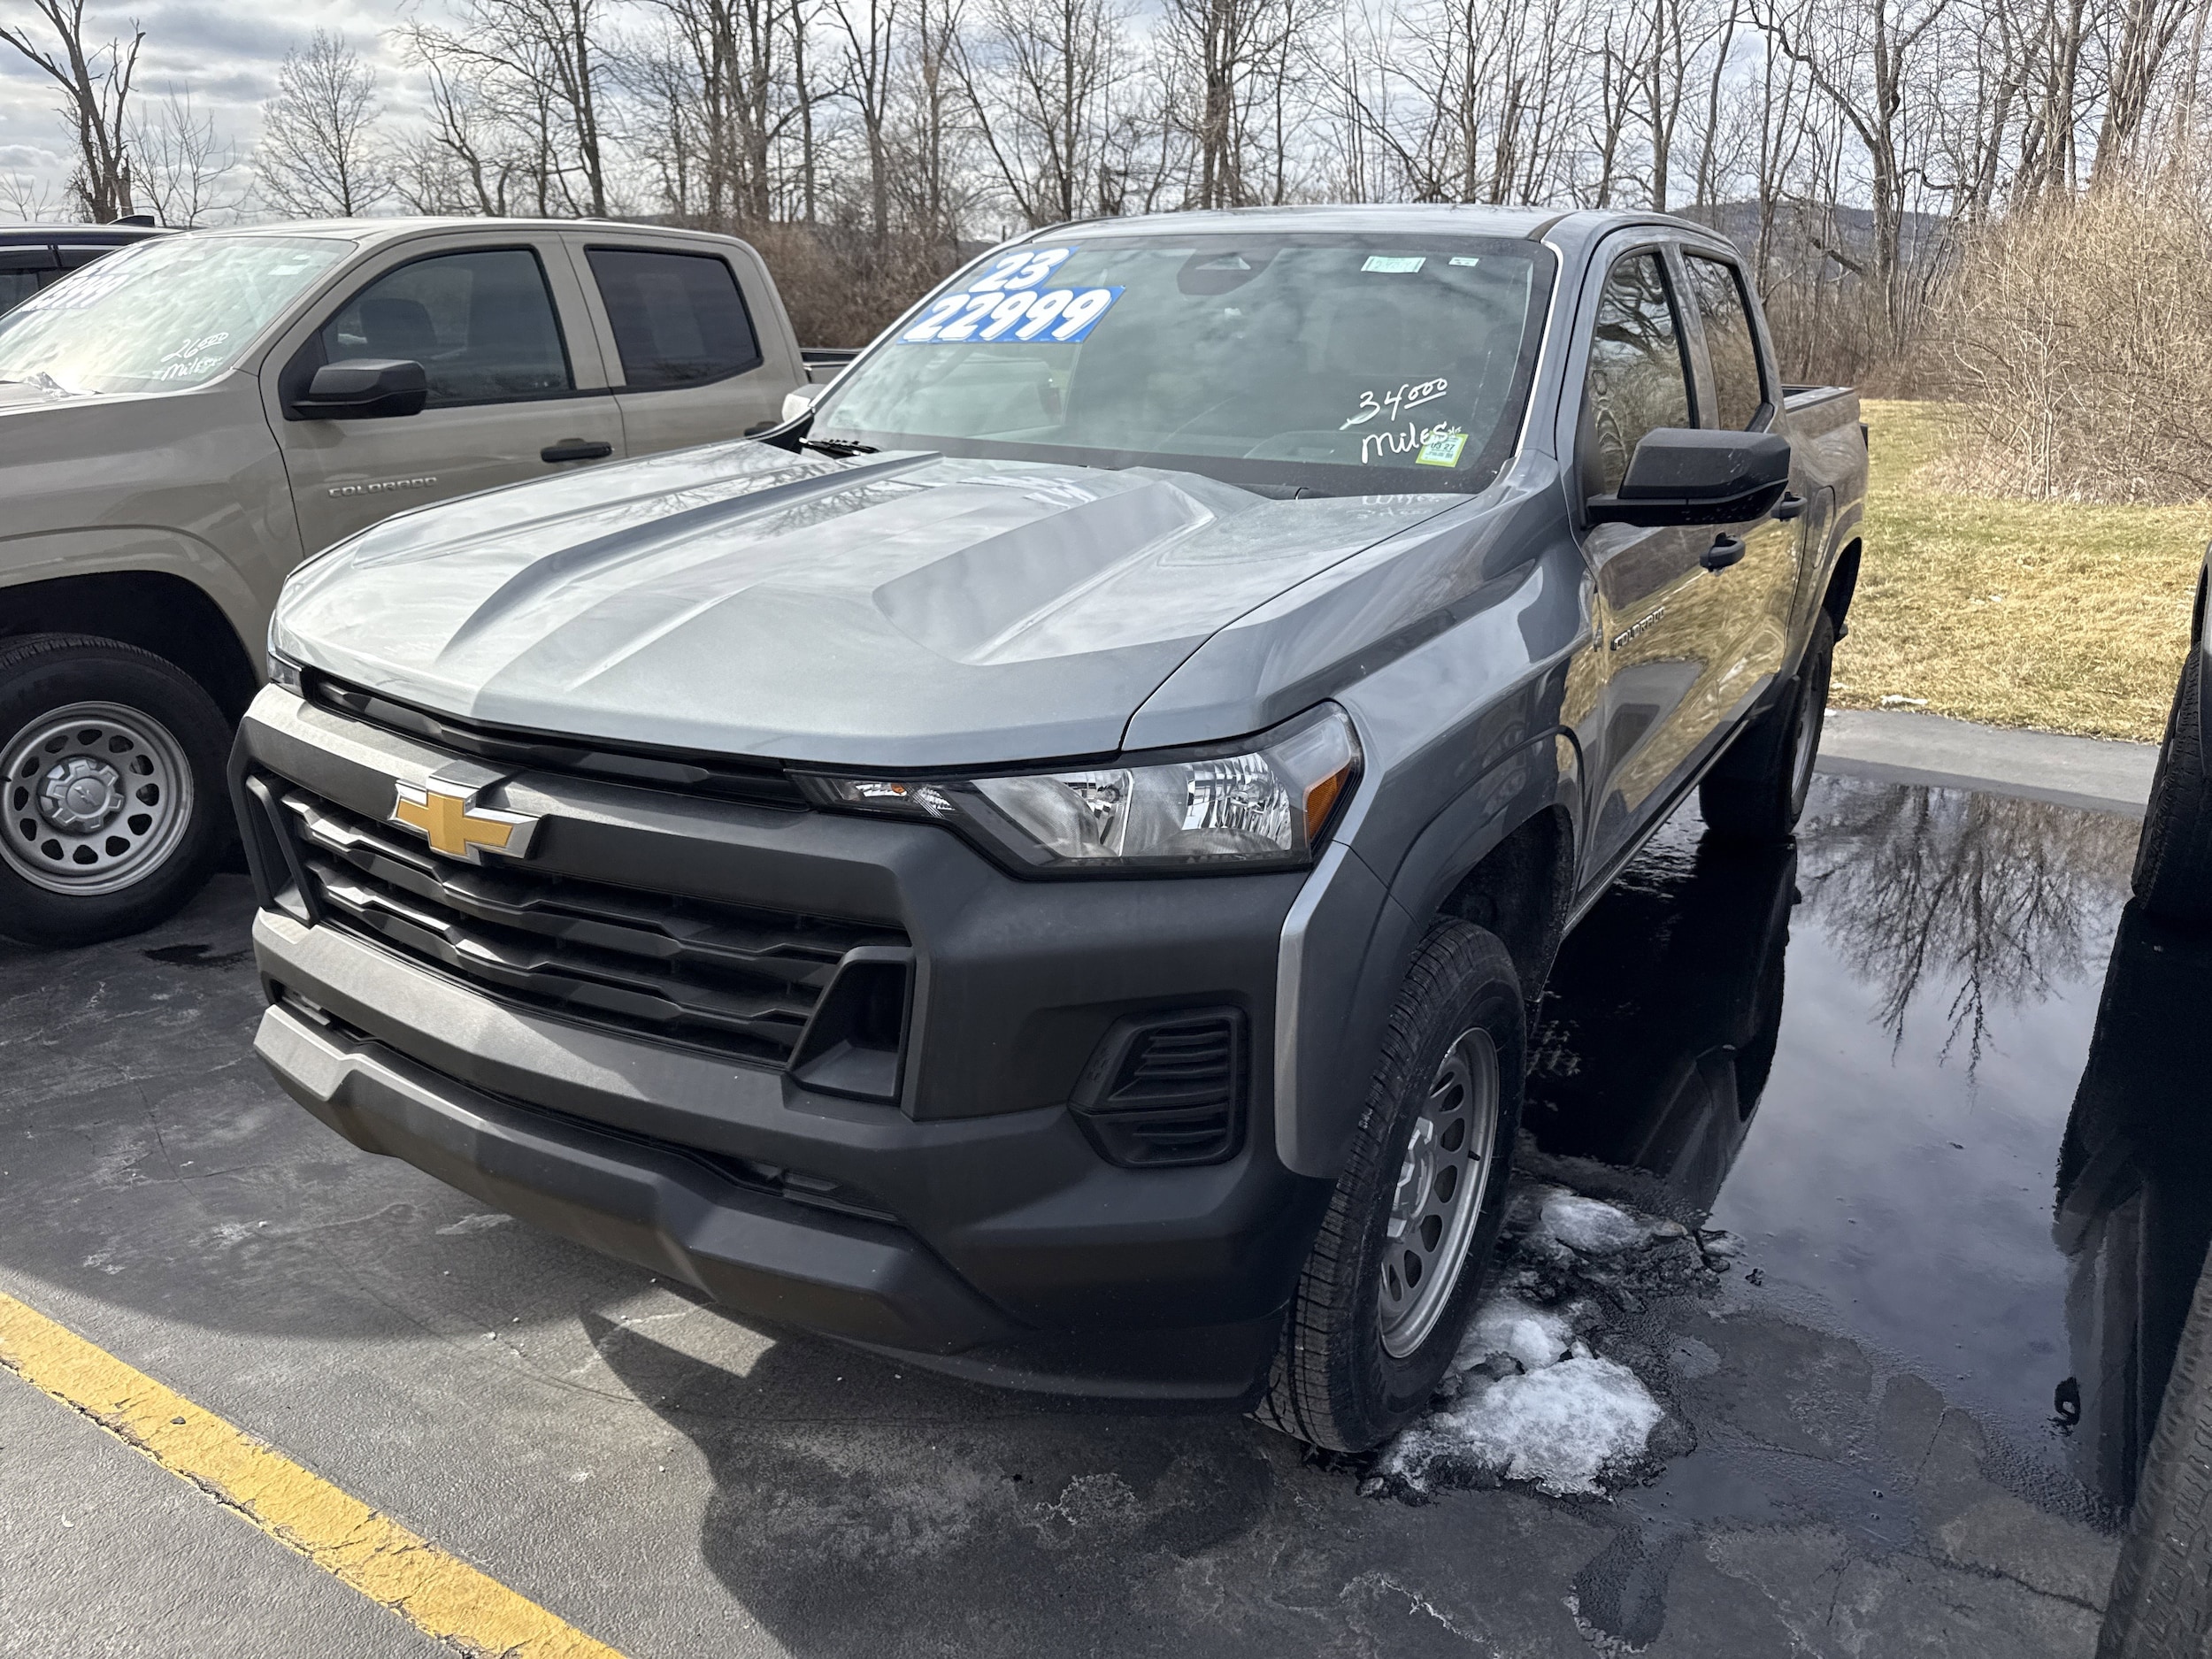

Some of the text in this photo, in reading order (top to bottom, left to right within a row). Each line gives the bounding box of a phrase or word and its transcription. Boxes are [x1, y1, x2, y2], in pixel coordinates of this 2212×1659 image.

[969, 248, 1070, 293] 23
[902, 289, 1112, 342] 22999
[1443, 443, 1455, 452] 27
[327, 476, 438, 498] COLORADO
